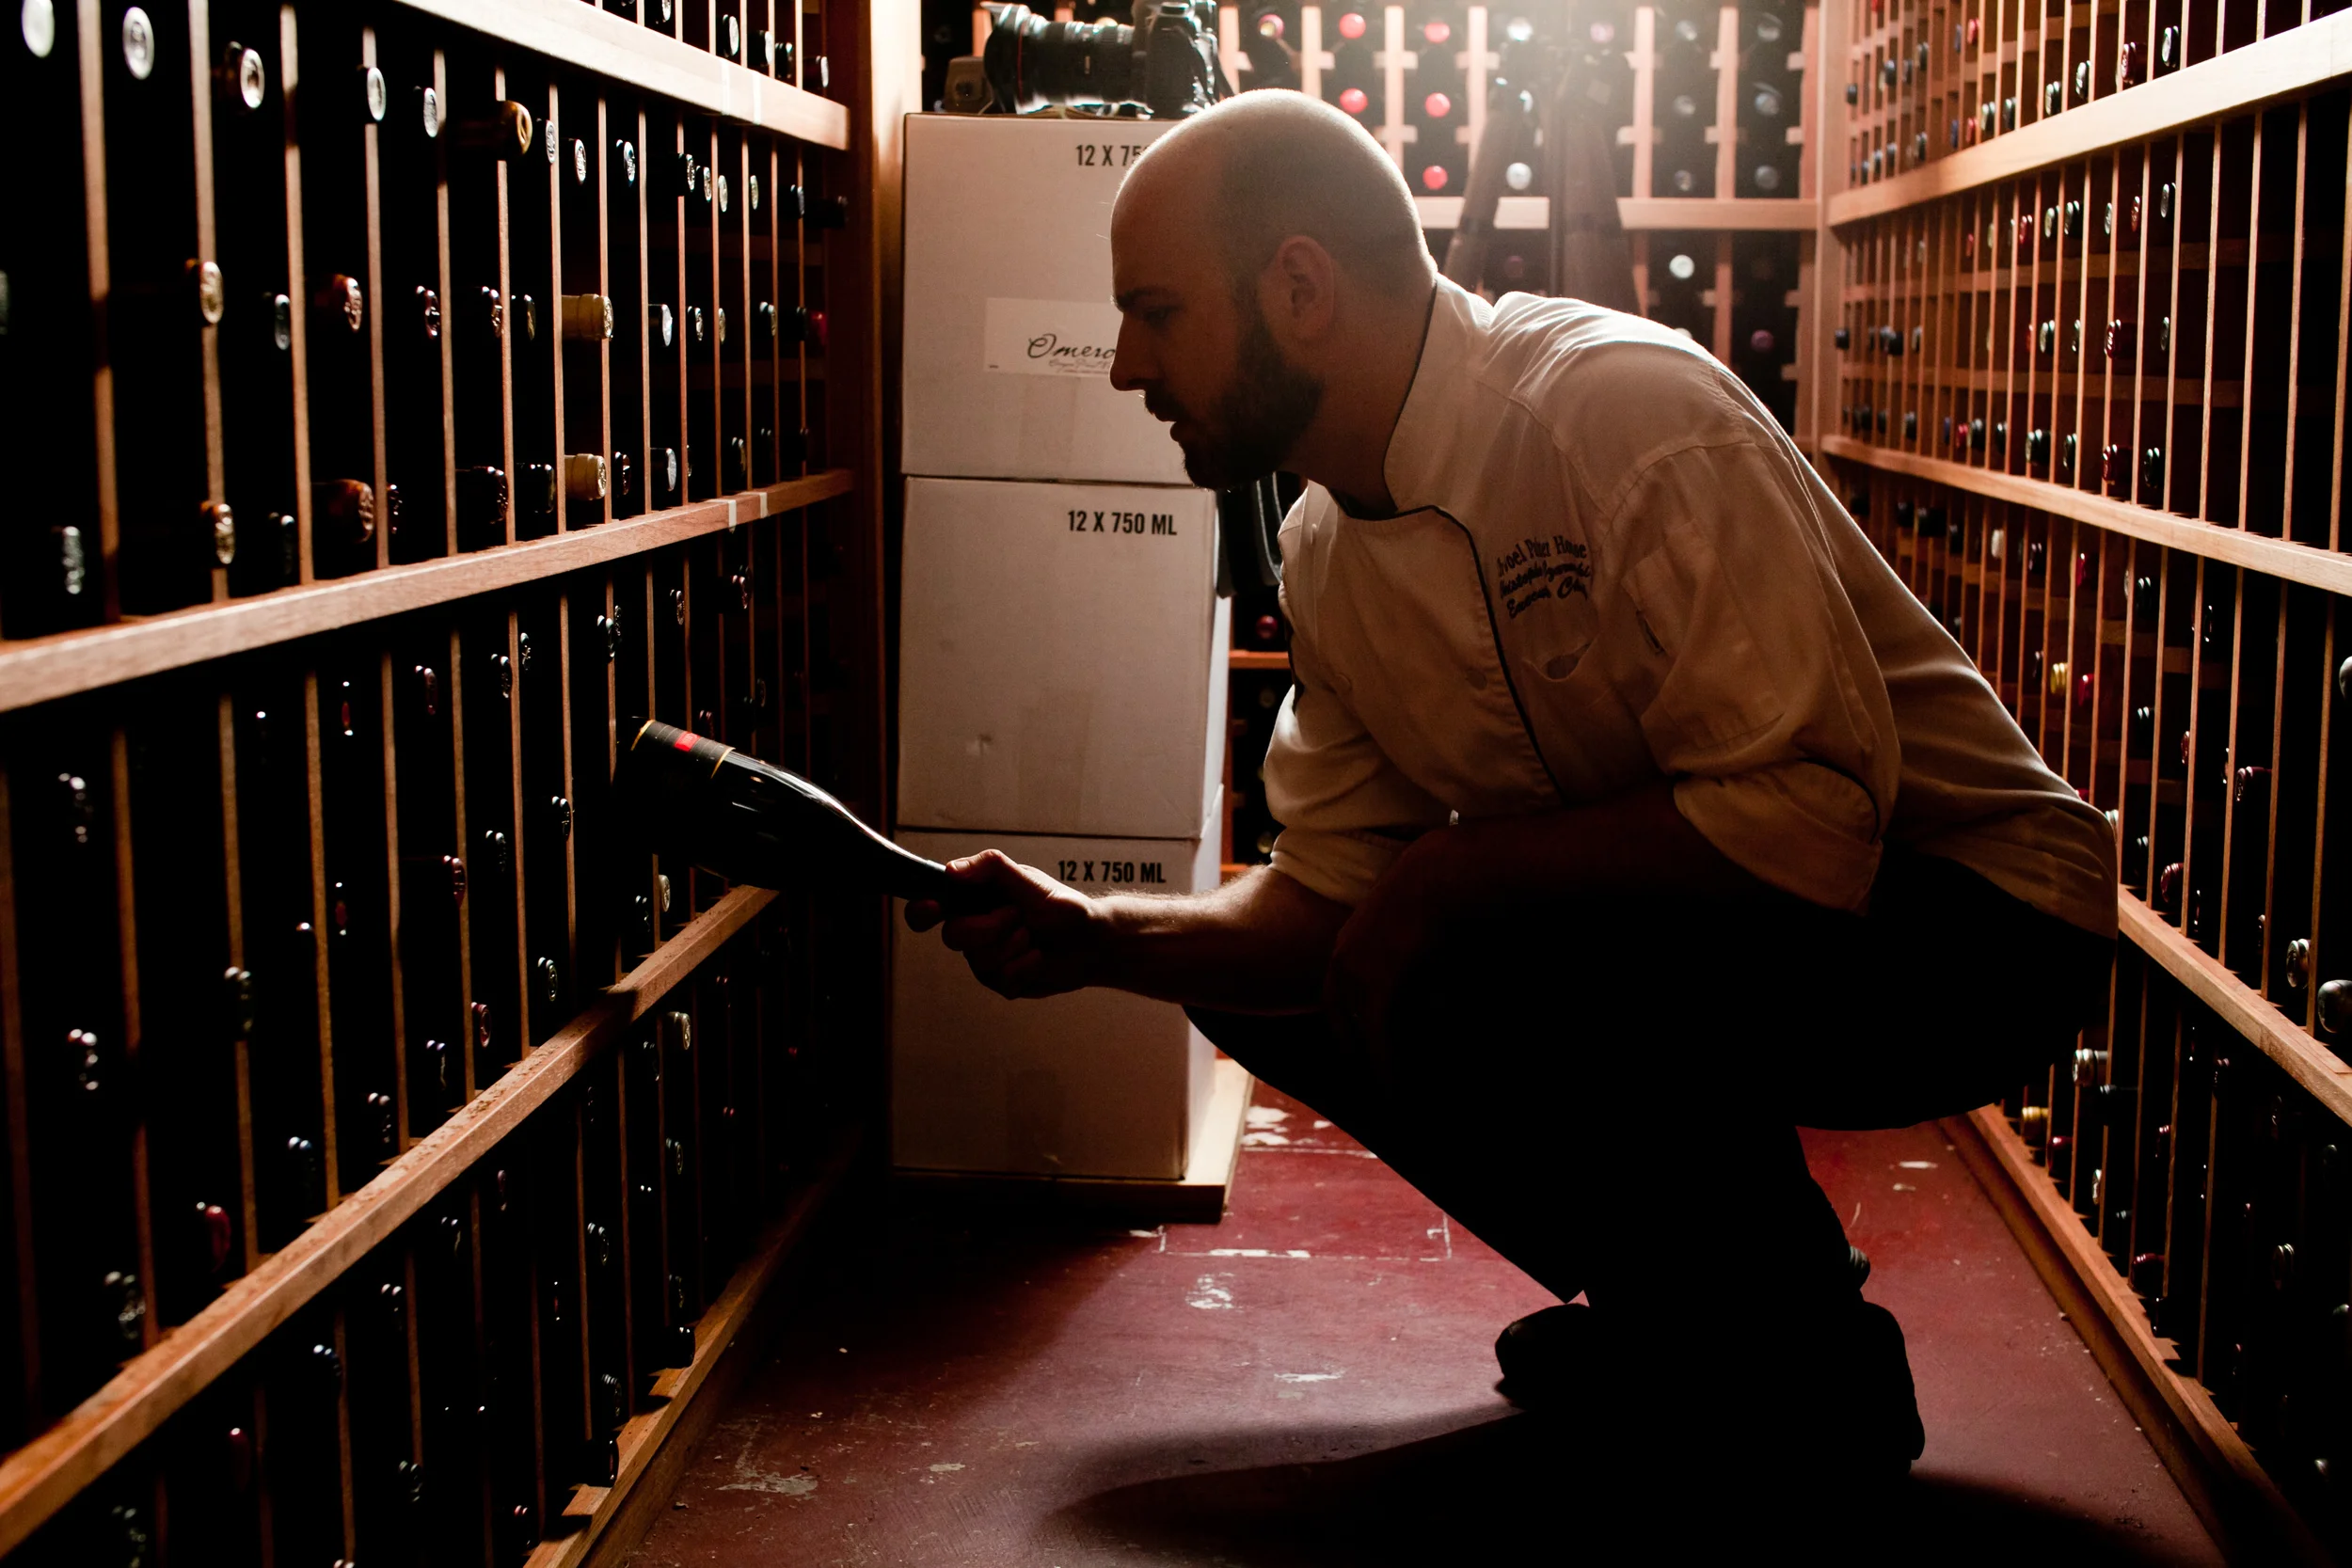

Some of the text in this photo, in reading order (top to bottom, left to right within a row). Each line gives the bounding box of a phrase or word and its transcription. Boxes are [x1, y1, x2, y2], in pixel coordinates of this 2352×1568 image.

[1075, 144, 1150, 166] 12 X 75
[1068, 510, 1177, 536] 12 X 750 ML
[1058, 860, 1167, 884] 12 X 750 ML
